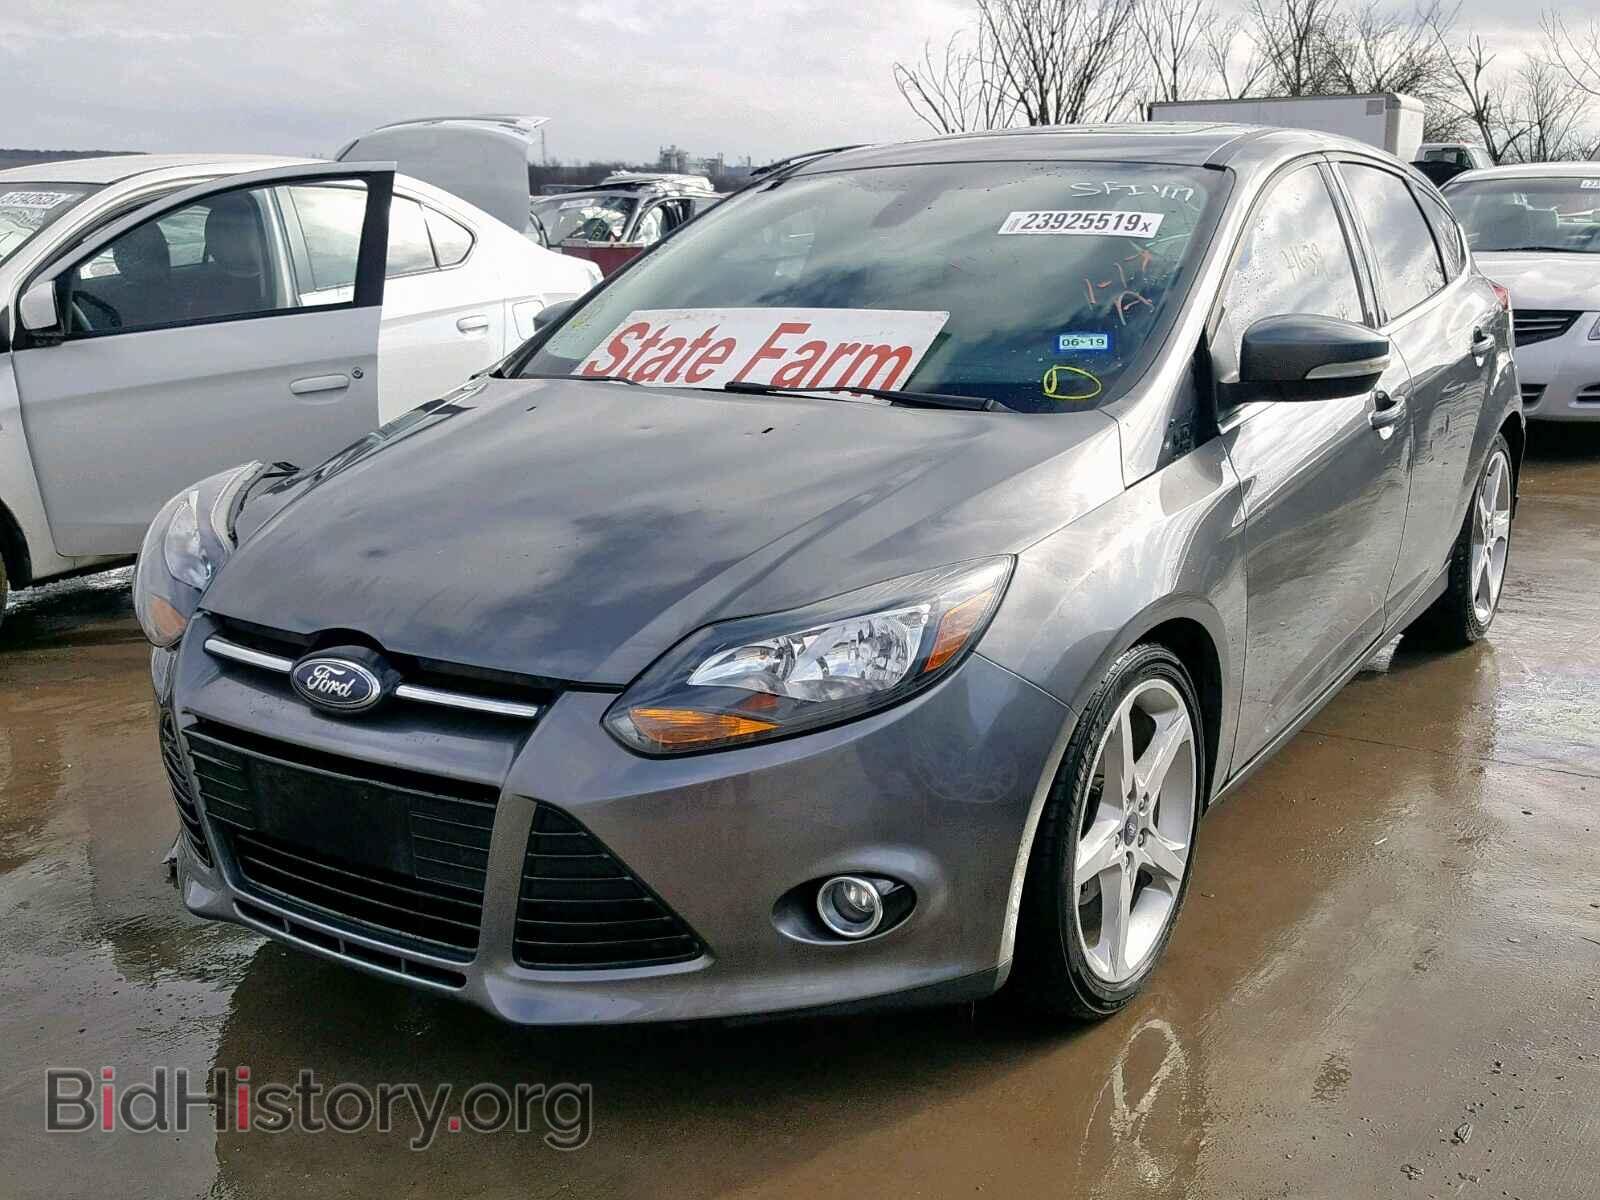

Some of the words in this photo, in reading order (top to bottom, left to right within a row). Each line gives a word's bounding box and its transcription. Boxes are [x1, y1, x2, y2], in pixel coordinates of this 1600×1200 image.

[582, 321, 737, 385] State
[735, 322, 914, 398] Farm
[307, 666, 356, 697] Ford
